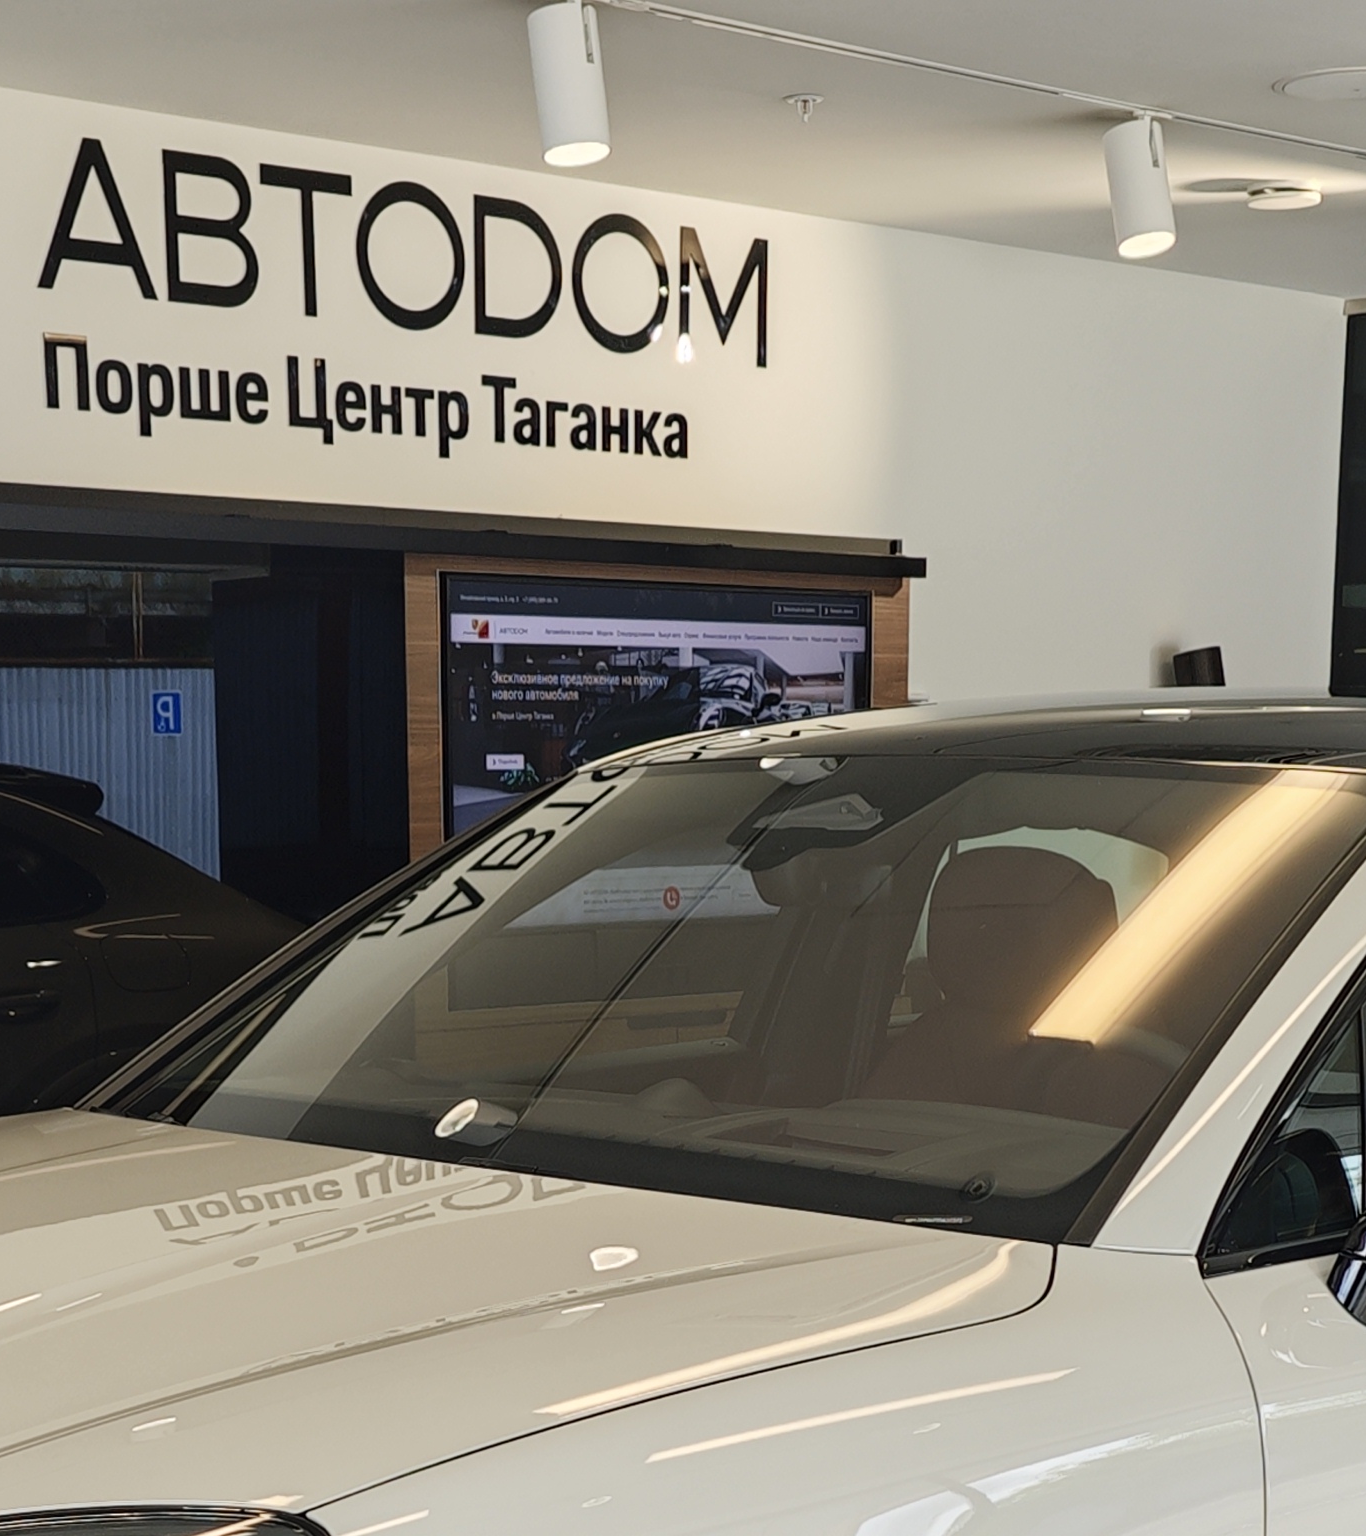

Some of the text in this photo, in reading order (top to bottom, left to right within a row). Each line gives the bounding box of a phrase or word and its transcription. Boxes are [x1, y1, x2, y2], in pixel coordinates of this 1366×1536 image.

[43, 331, 689, 460] Порше Центр Таганка
[491, 670, 670, 690] Эксклюзивное предложение на покупку
[491, 687, 580, 702] нового автомобиля
